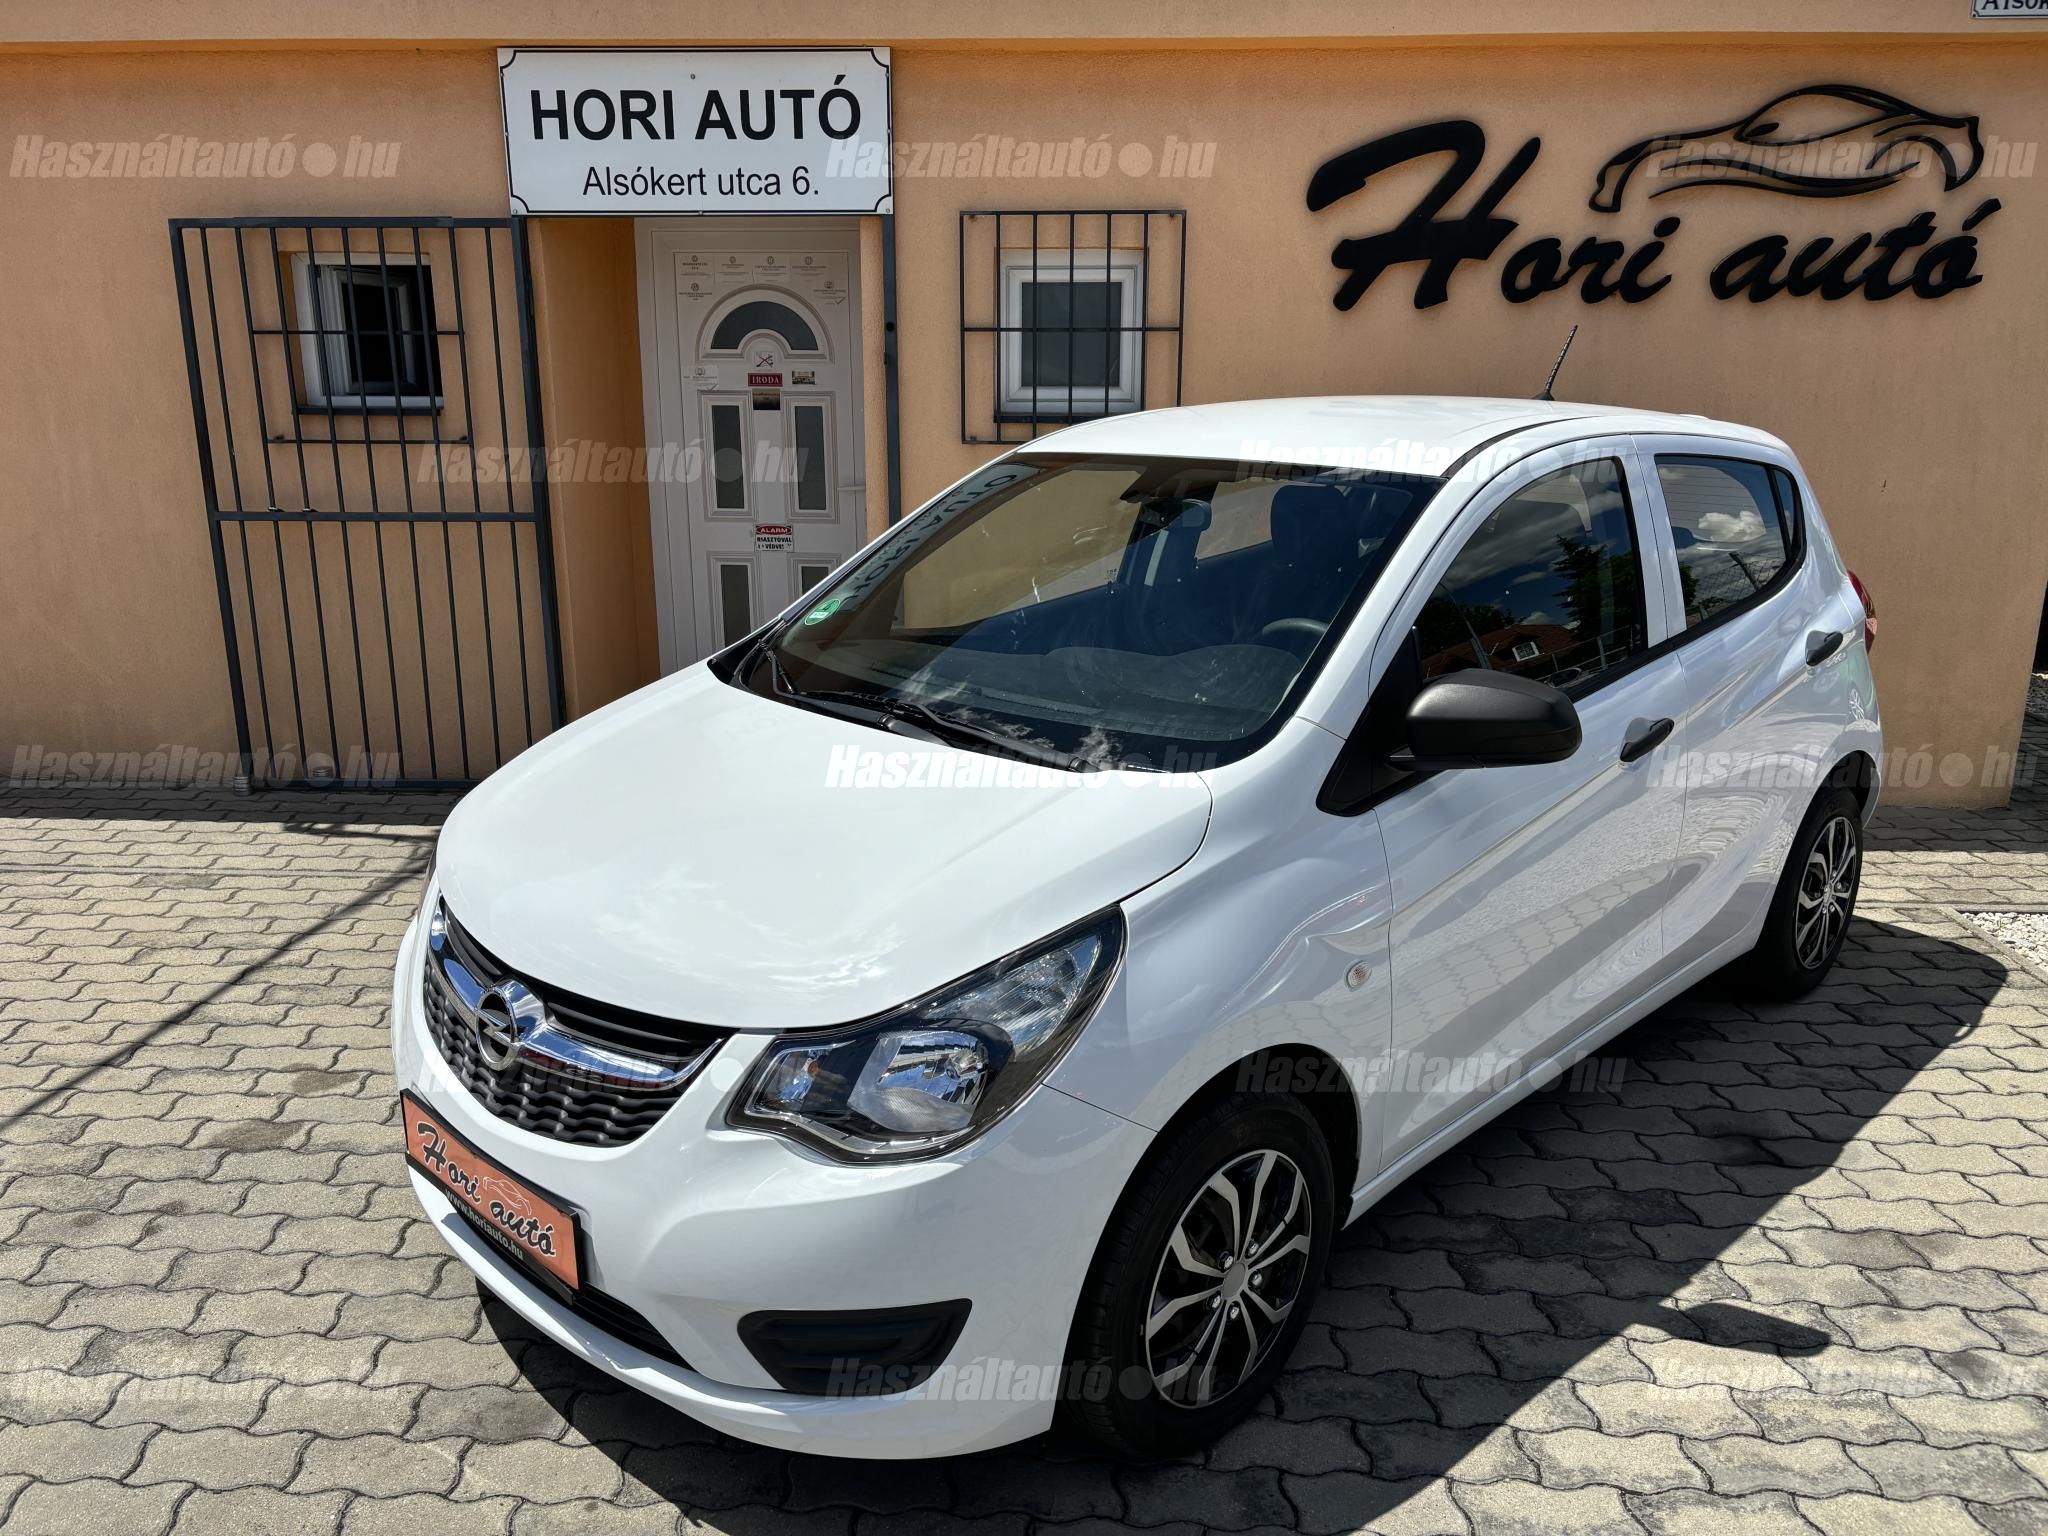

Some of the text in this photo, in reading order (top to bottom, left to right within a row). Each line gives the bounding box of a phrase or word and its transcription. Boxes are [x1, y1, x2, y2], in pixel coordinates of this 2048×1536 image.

[530, 75, 861, 140] HORI AUTÓ
[582, 166, 819, 196] Alsókert utca 6.
[1306, 119, 2001, 311] Hori autó
[752, 375, 780, 384] IRODA
[417, 1121, 557, 1258] Hori autó
[445, 1188, 524, 1259] www.horiauto.hu
